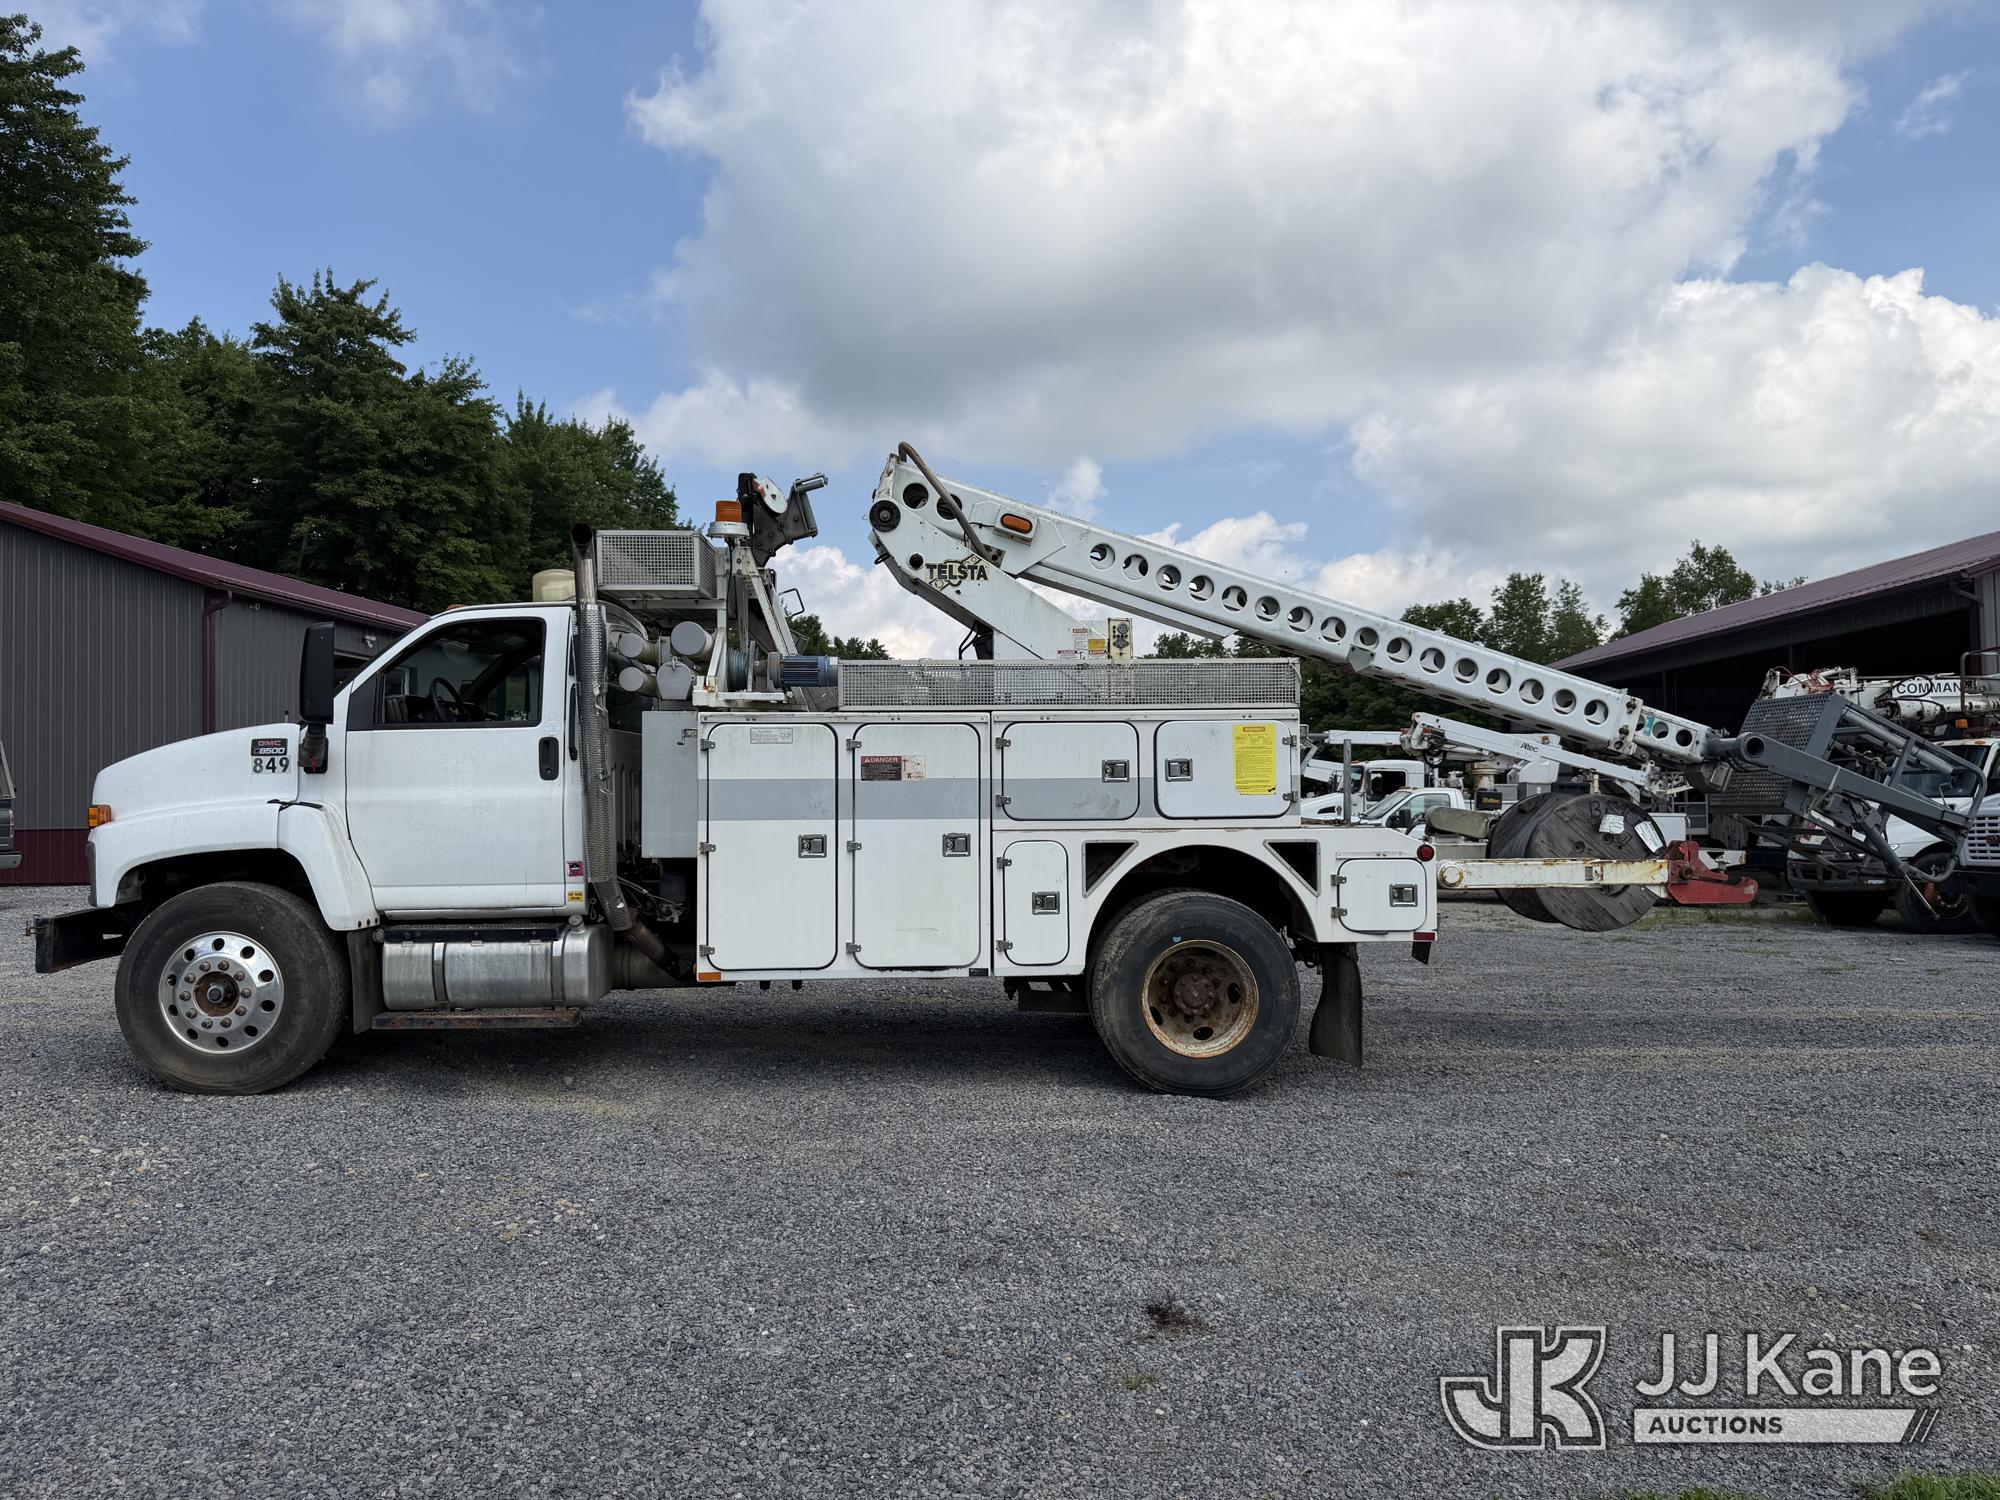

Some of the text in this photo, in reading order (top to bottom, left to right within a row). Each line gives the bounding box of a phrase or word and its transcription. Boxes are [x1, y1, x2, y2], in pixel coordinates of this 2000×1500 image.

[925, 563, 988, 580] TELSTA
[1519, 742, 1539, 753] Altec
[253, 757, 289, 773] 849
